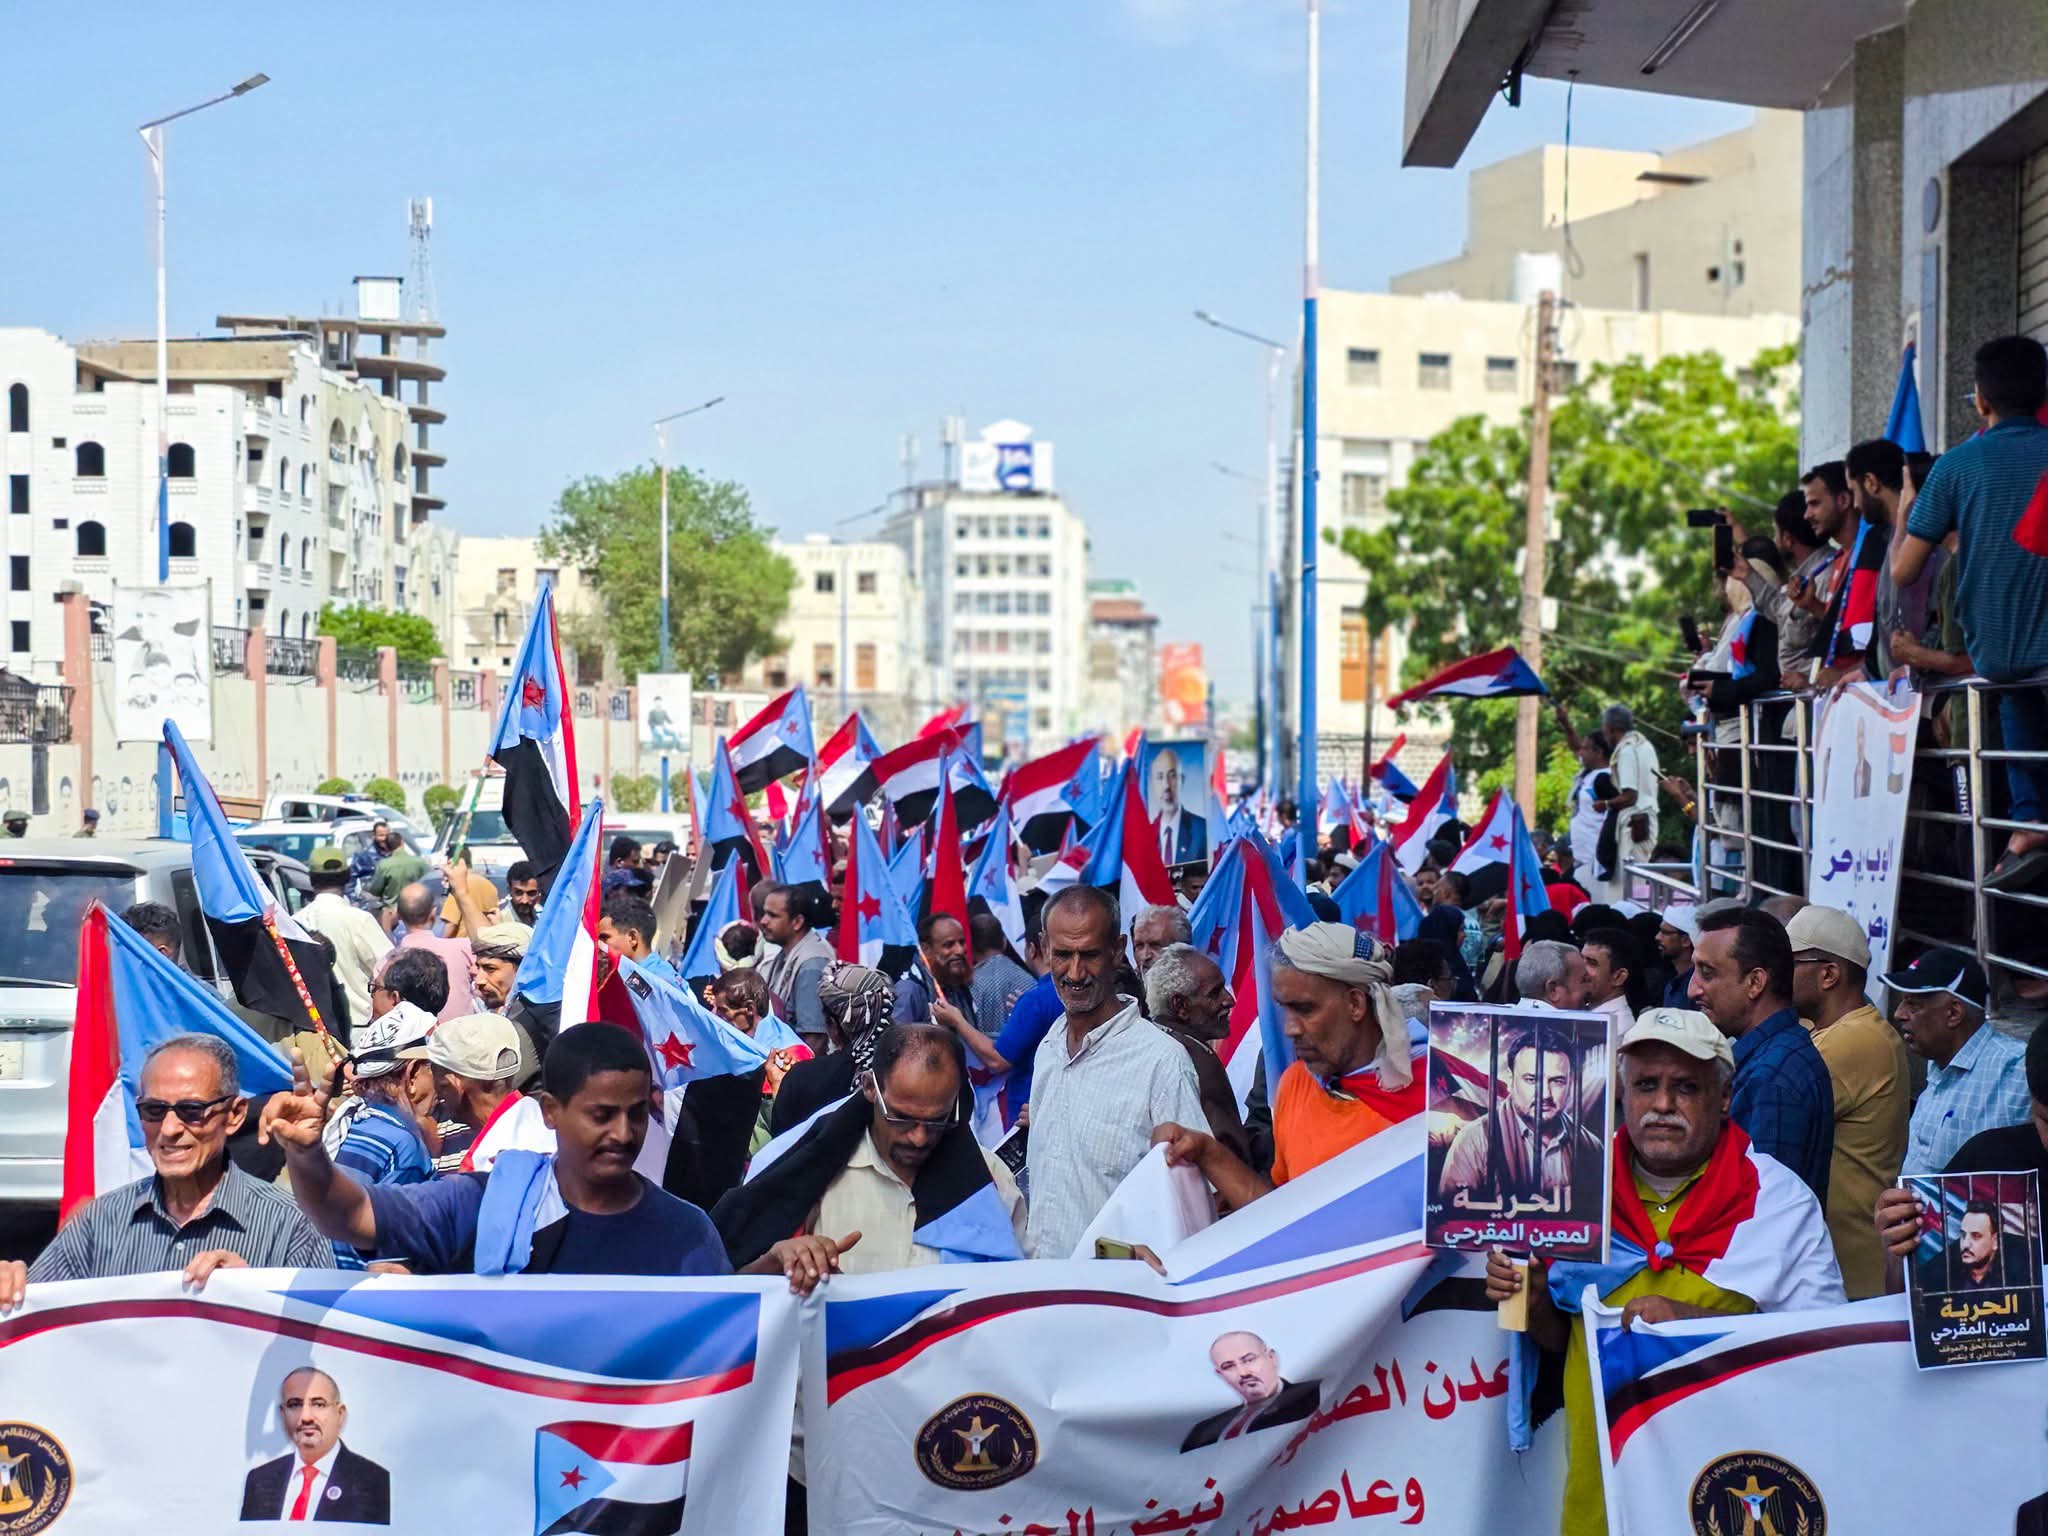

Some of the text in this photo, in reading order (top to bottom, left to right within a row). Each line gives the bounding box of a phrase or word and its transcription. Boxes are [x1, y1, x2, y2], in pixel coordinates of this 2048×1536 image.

[1453, 1184, 1572, 1219] الحرية
[1444, 1222, 1590, 1248] لمعين المقرحي
[1940, 1294, 2018, 1322] الحرية
[1931, 1319, 2030, 1345] لمعين المقرحي
